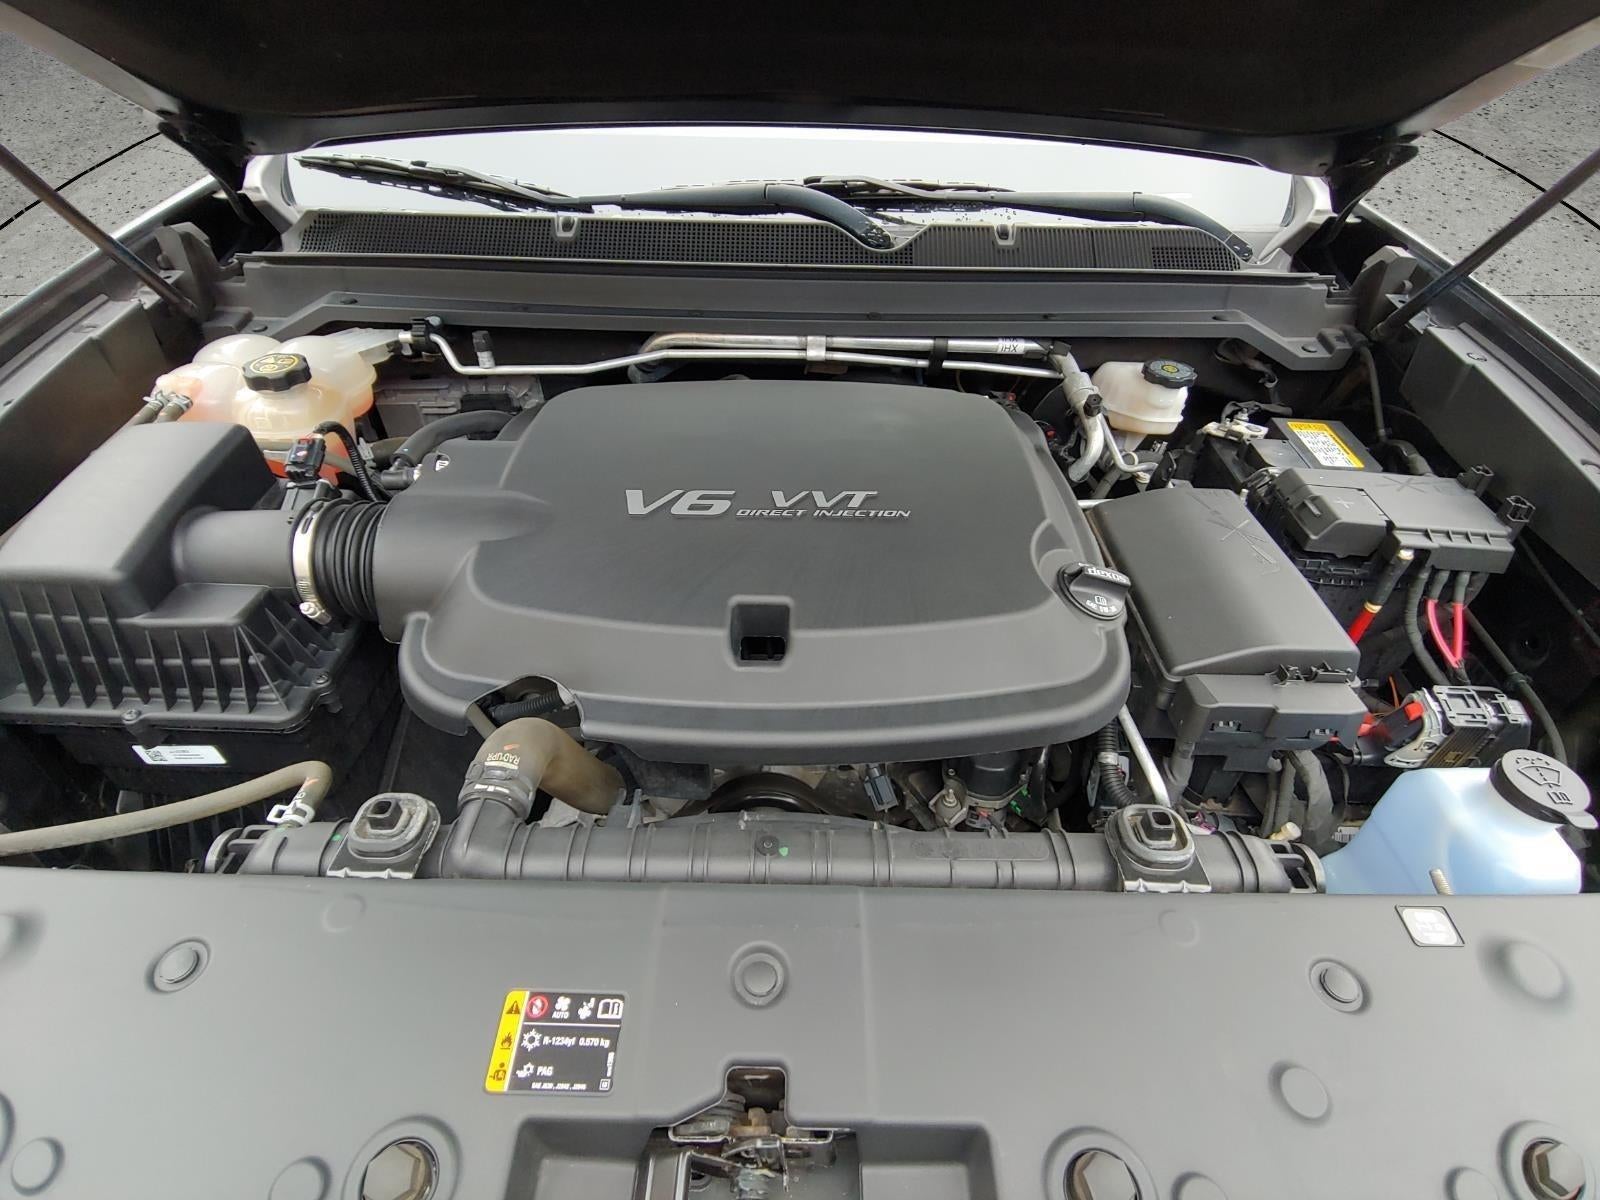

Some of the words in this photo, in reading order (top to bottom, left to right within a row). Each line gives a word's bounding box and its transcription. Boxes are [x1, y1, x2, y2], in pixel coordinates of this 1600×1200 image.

[625, 489, 736, 515] V6
[771, 490, 878, 508] VVT
[736, 509, 807, 517] DIRECT
[813, 509, 911, 518] INJECTION
[1087, 567, 1127, 583] dexos
[551, 1011, 569, 1019] AUTO
[536, 1066, 554, 1076] PAG
